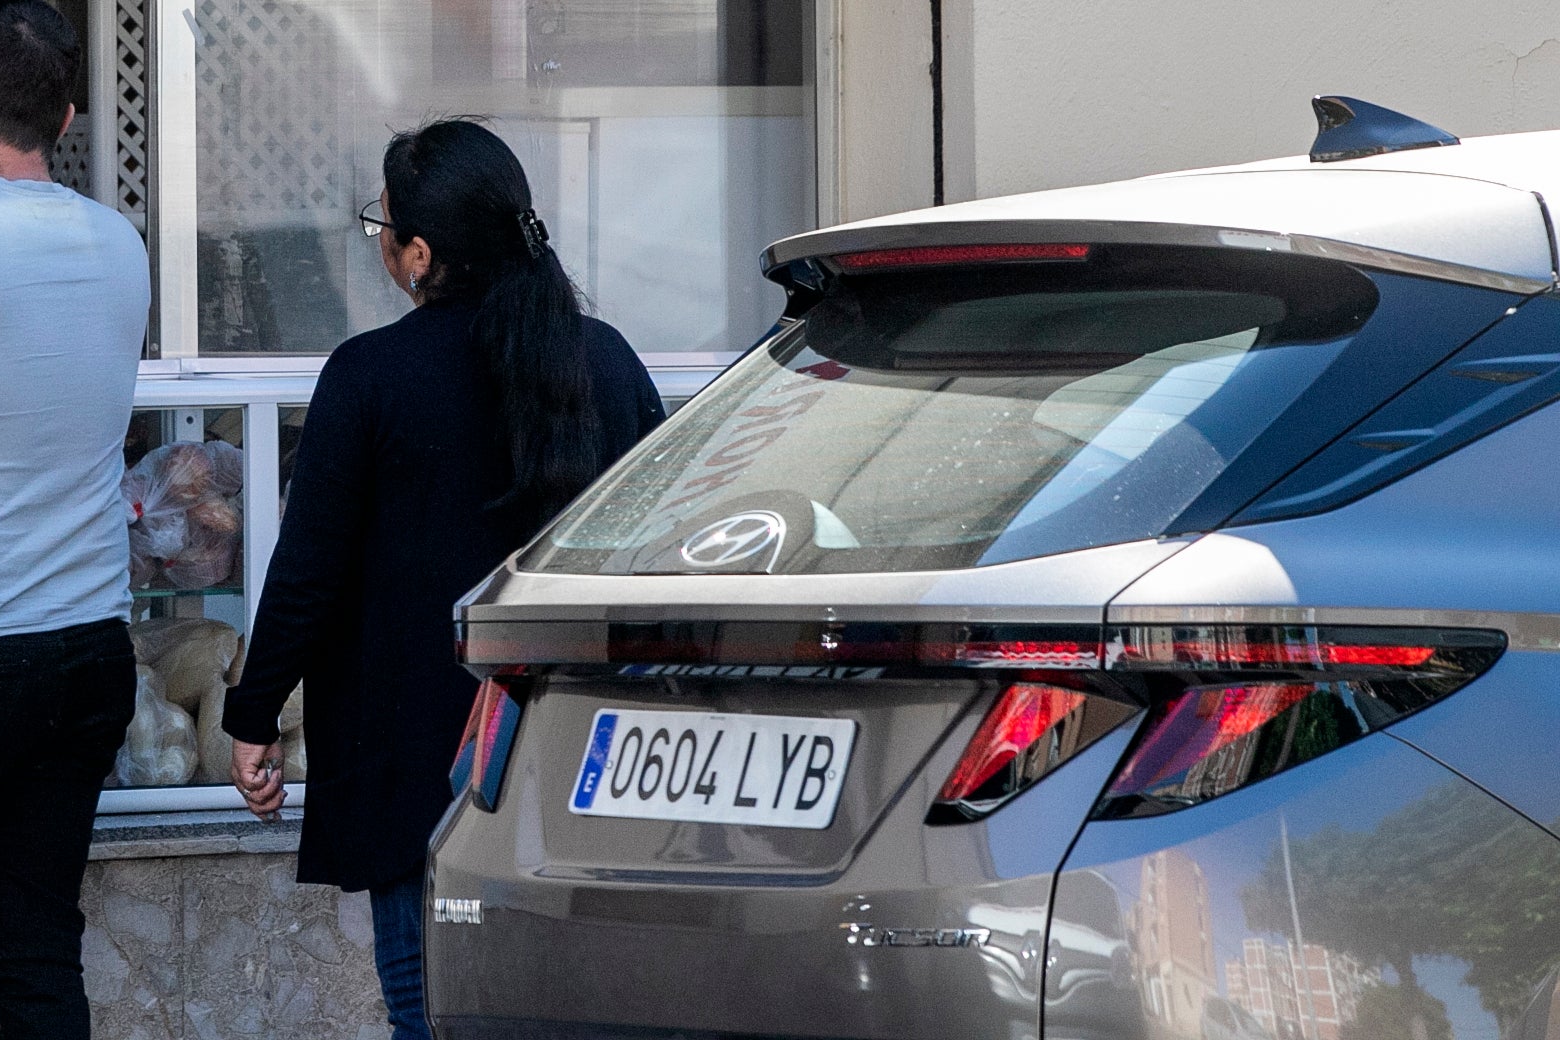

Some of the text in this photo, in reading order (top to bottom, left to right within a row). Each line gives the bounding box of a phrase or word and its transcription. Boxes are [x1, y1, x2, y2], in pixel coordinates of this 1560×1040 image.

[582, 772, 597, 793] E
[609, 725, 835, 811] 0604 LYB
